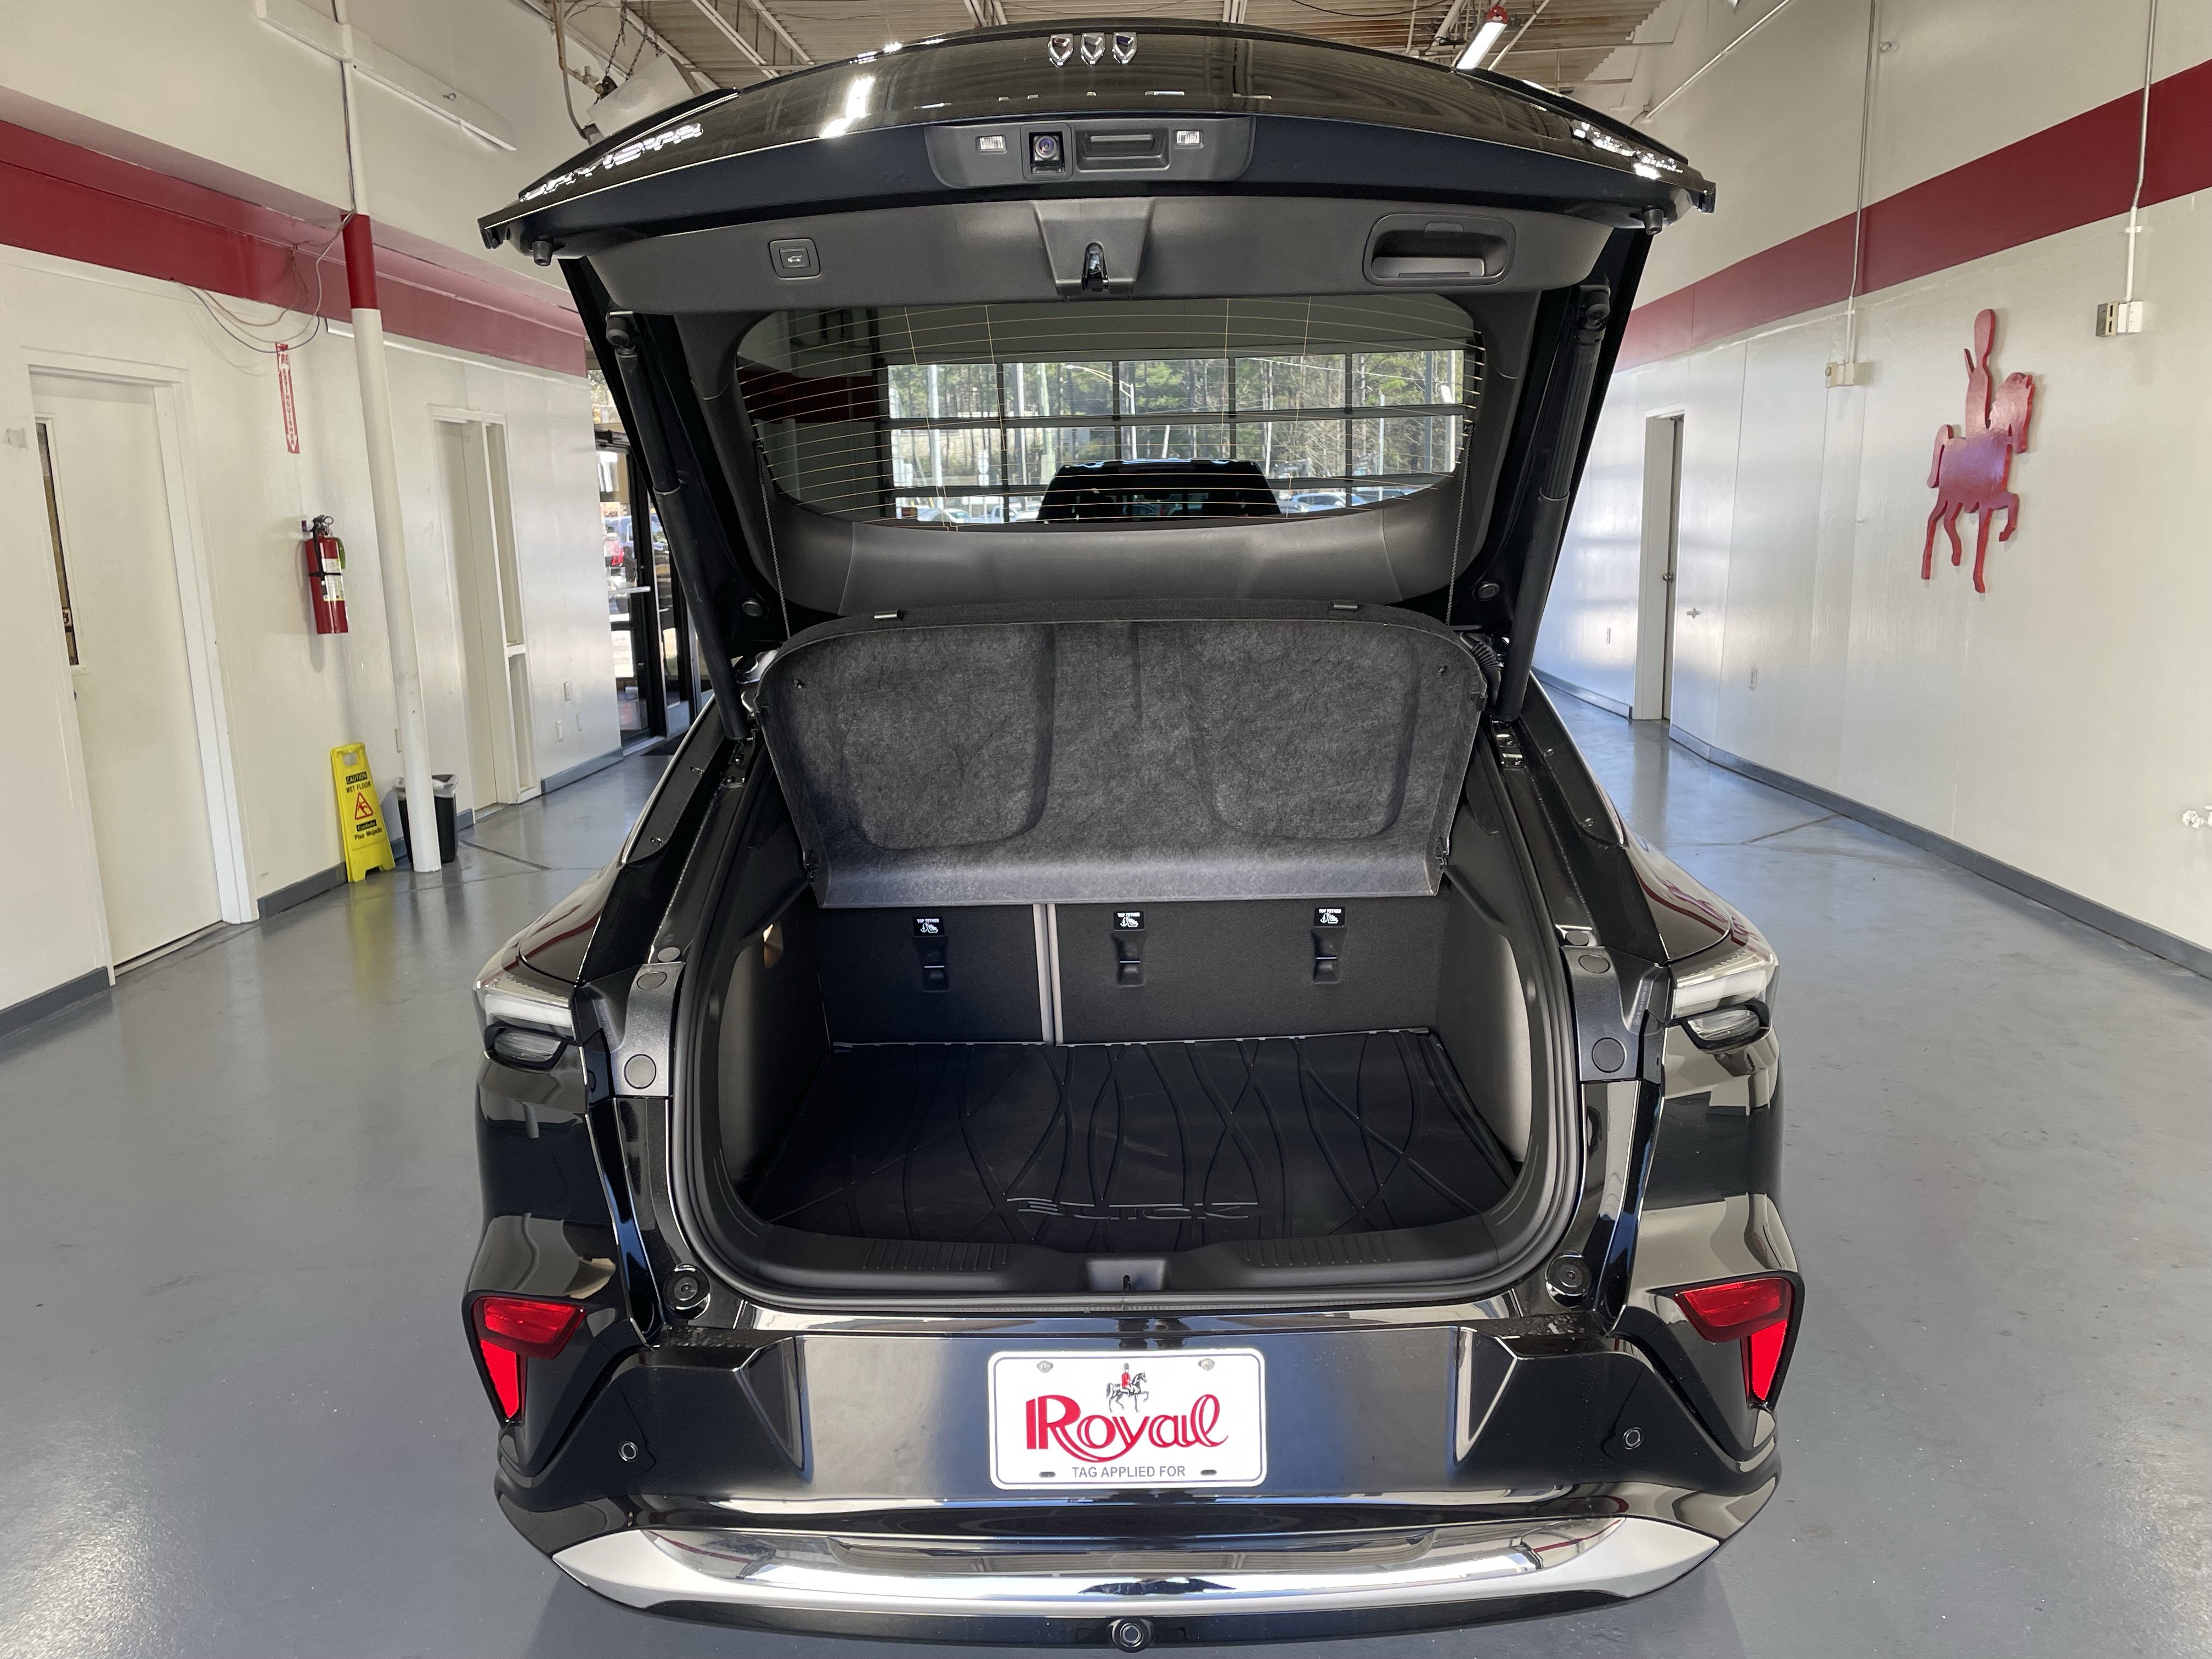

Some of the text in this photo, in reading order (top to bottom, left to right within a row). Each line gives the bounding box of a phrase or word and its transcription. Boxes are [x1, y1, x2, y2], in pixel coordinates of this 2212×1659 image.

[283, 368, 295, 445] EXTINGUISHER
[347, 773, 367, 783] CAUTION
[346, 781, 371, 793] WET FLOOR
[1026, 1394, 1228, 1463] Royal
[1072, 1466, 1186, 1478] TAG APPLIED FOR
